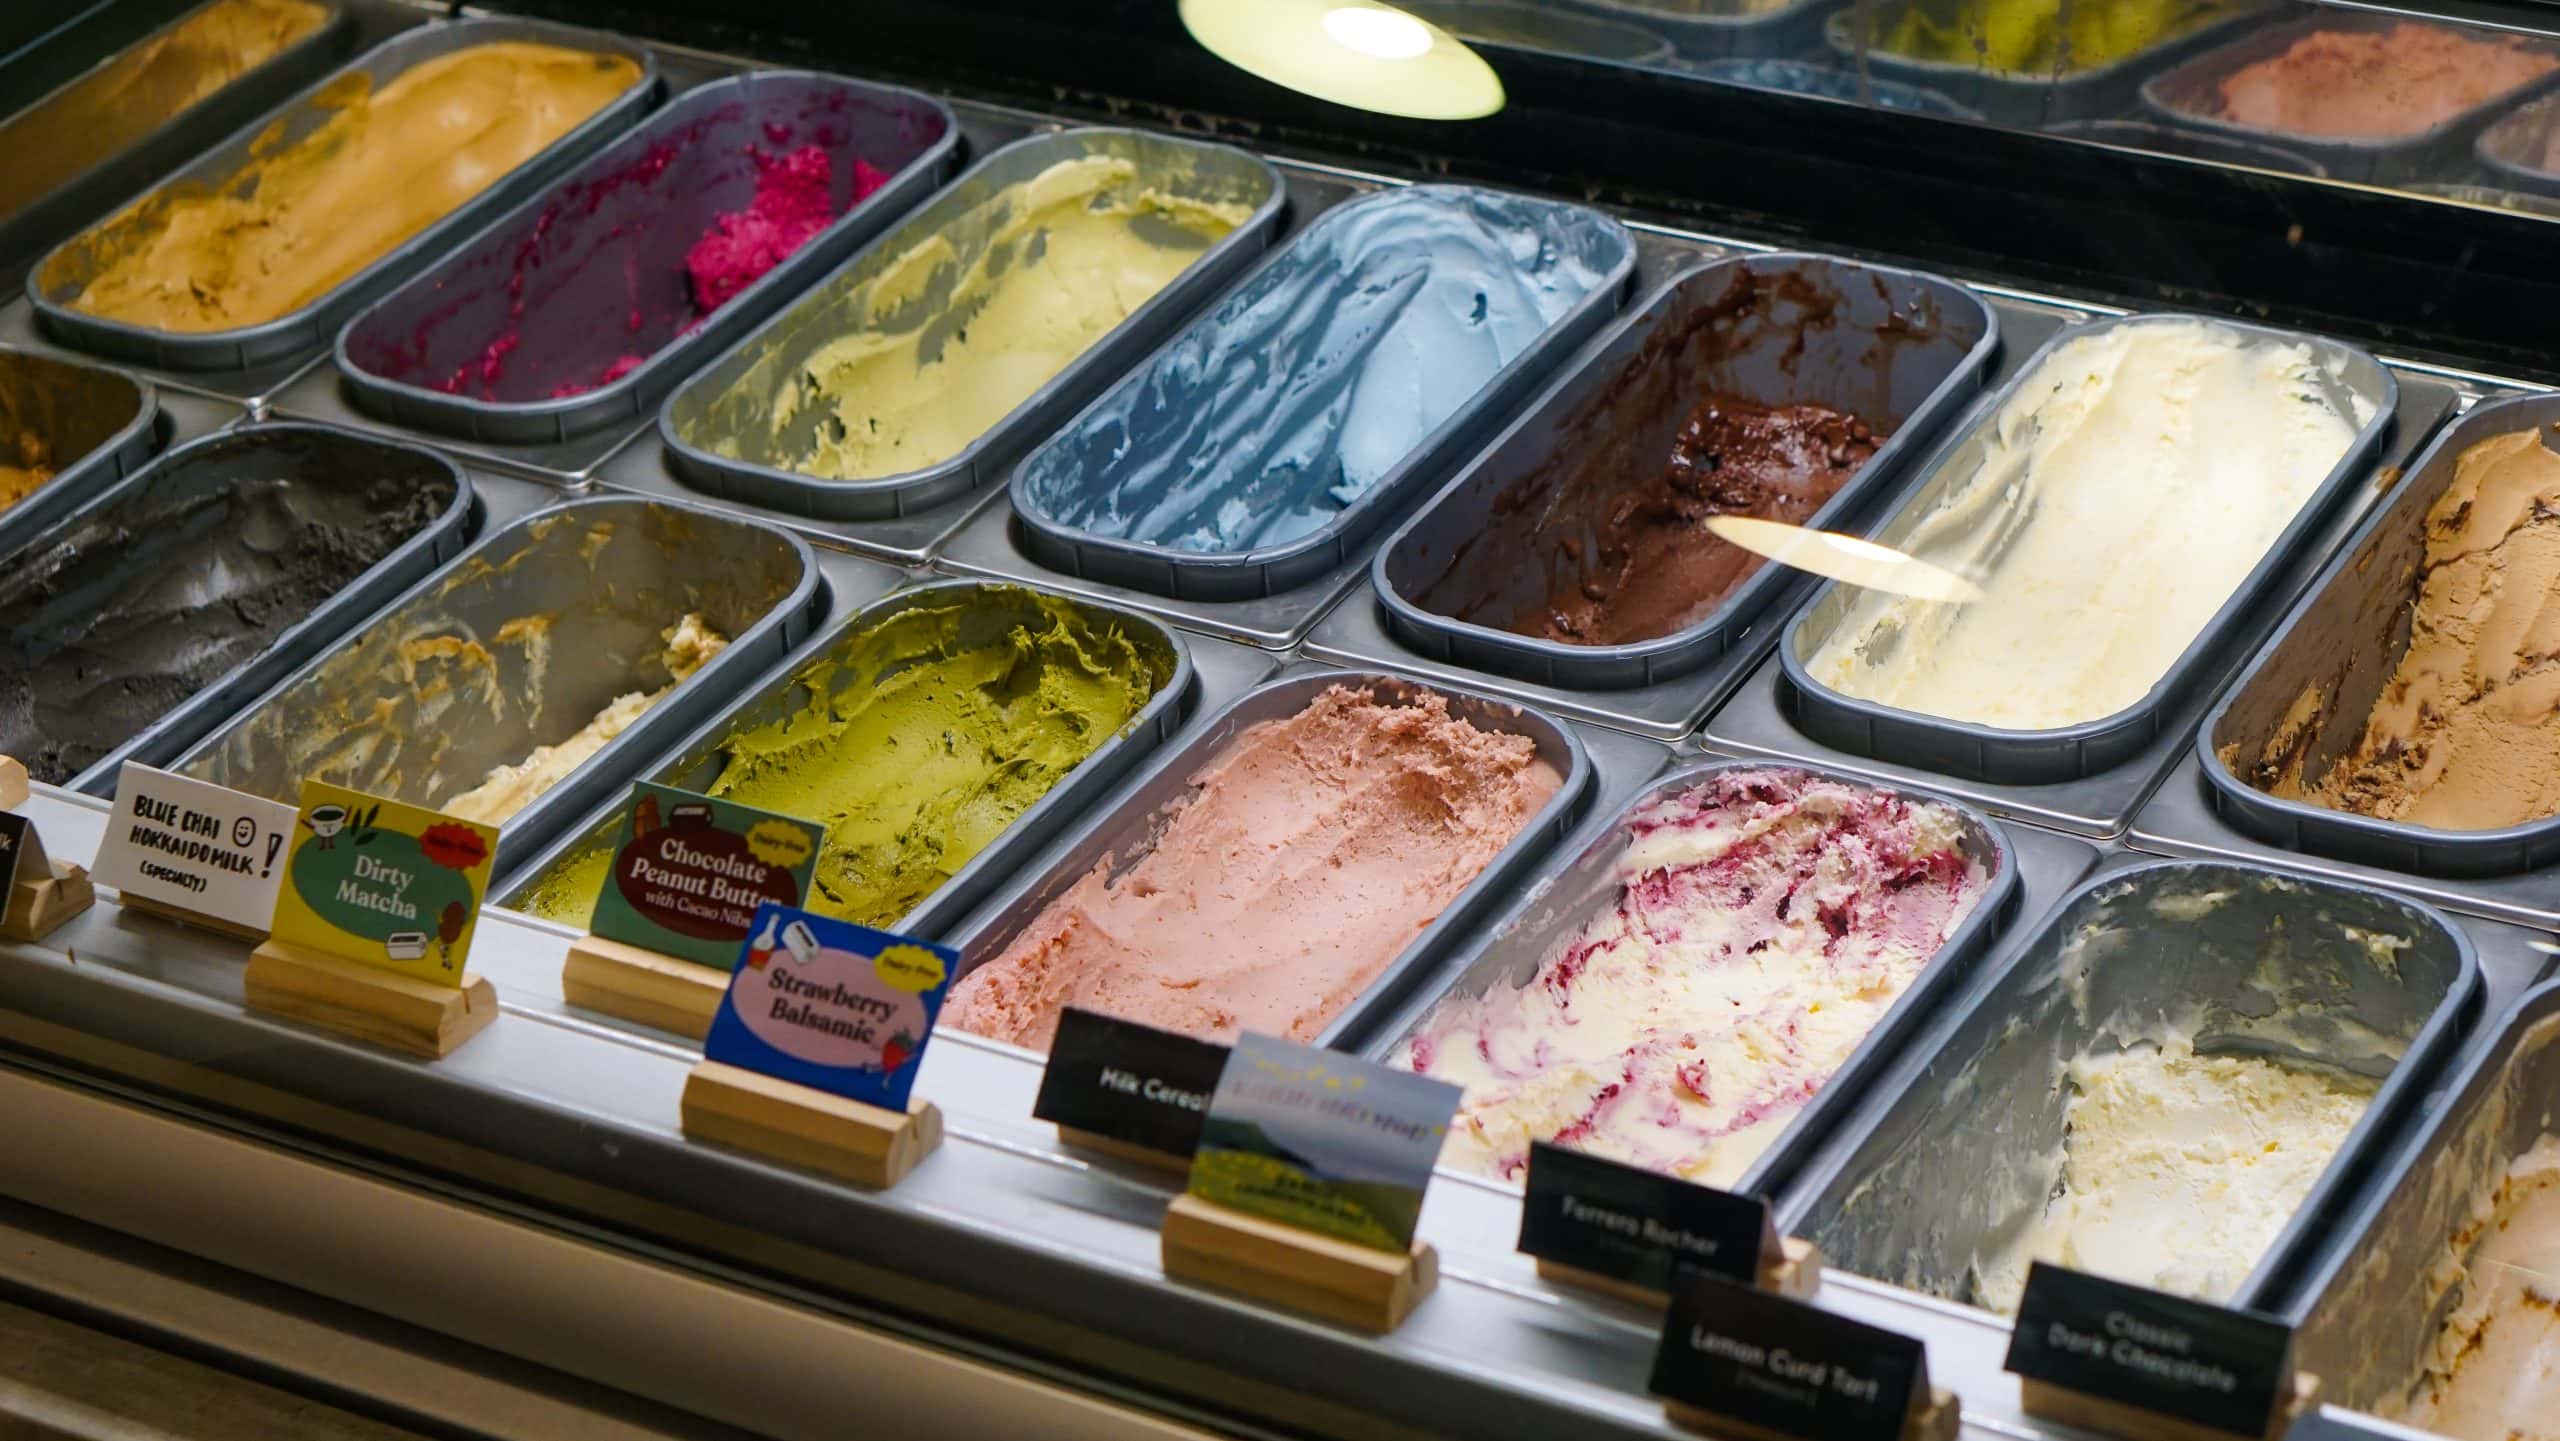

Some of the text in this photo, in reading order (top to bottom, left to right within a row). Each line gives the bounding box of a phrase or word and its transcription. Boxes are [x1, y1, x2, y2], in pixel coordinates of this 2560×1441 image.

[133, 794, 221, 839] BLUE CHAI
[354, 853, 415, 893] Dirty
[630, 856, 708, 896] Peanut
[660, 837, 768, 884] Chocolate
[335, 879, 418, 919] Matcha
[645, 890, 675, 910] with
[676, 897, 719, 921] Cacao
[768, 966, 899, 1024] Strawberry
[768, 996, 876, 1045] Balsamic
[1099, 1066, 1141, 1096] Milk
[1143, 1077, 1210, 1112] Cereal
[1690, 1322, 1766, 1368] Lemon
[1768, 1347, 1827, 1386] Curd
[1831, 1365, 1880, 1403] Tart
[2047, 1321, 2236, 1393] Dark Chocolate
